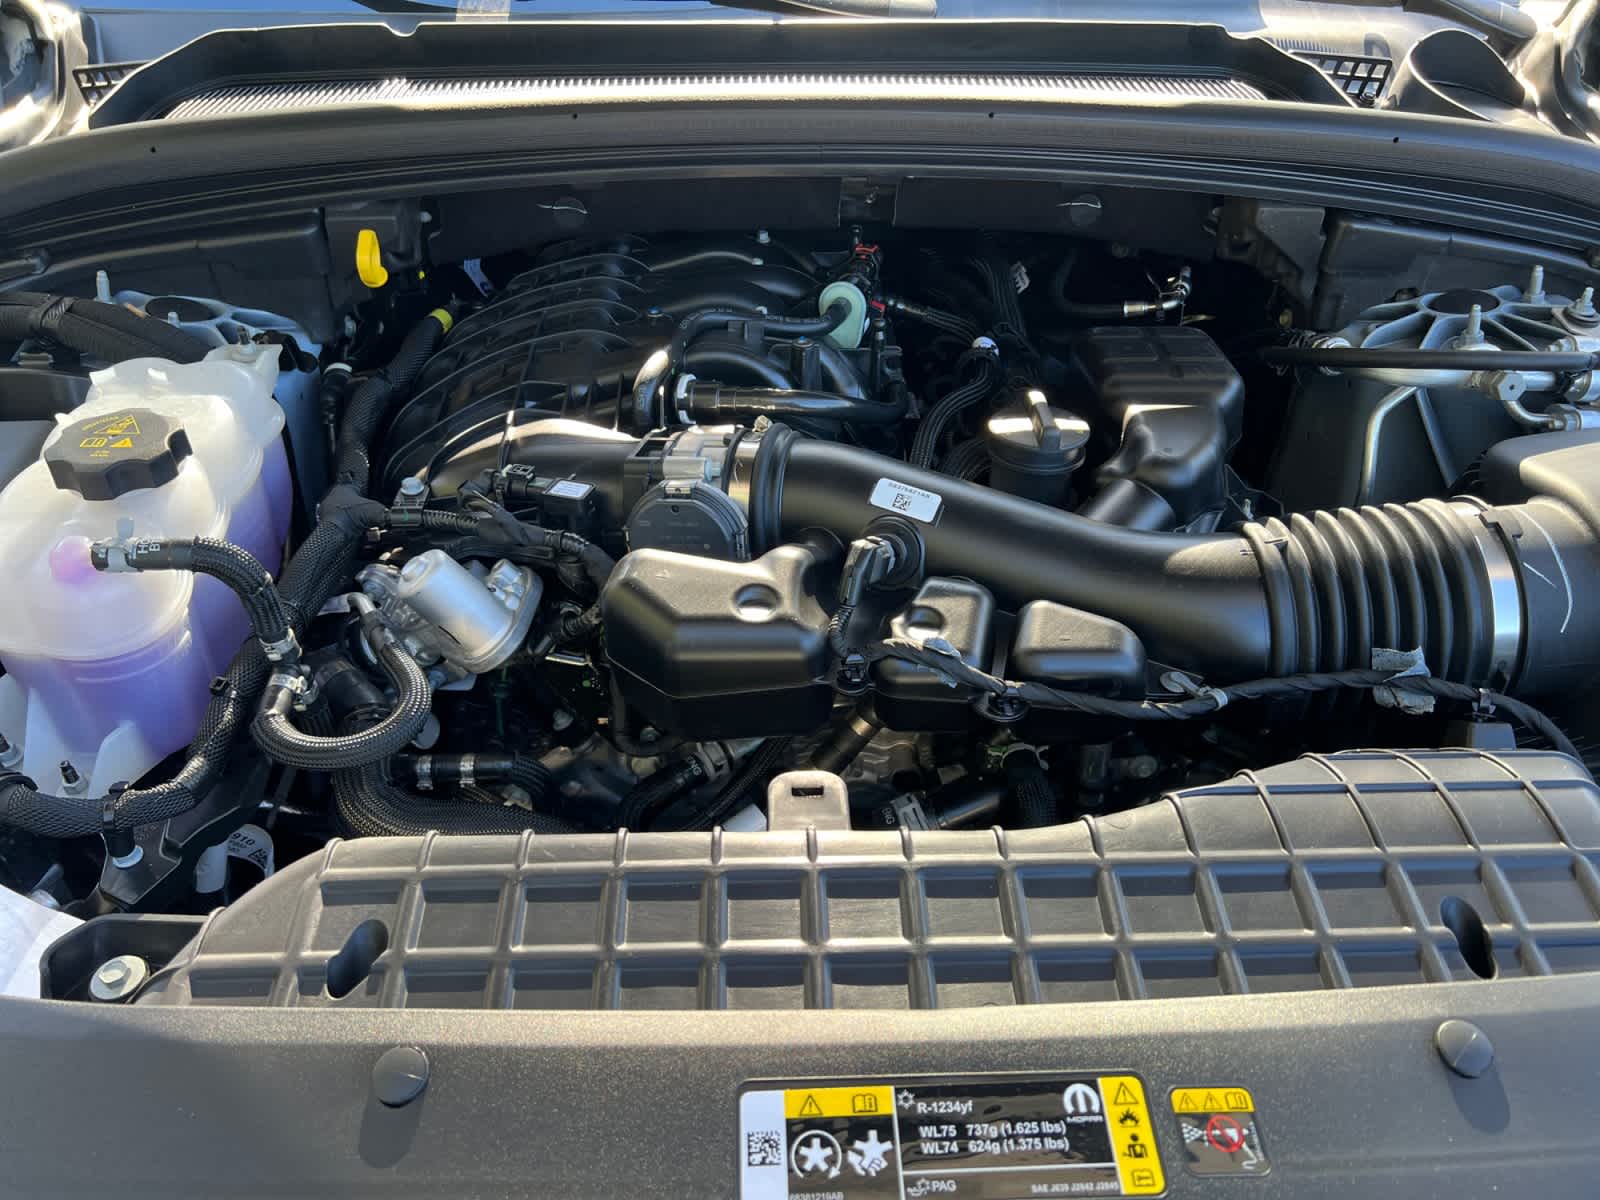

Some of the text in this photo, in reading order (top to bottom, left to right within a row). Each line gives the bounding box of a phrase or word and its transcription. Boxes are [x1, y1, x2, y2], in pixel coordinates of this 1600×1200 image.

[916, 1099, 973, 1116] R-1234yf
[919, 1119, 1067, 1139] WL75 737g (1.625 lbs)
[921, 1136, 1070, 1155] WL74 624g (1.375 lbs)
[931, 1179, 957, 1192] PAG
